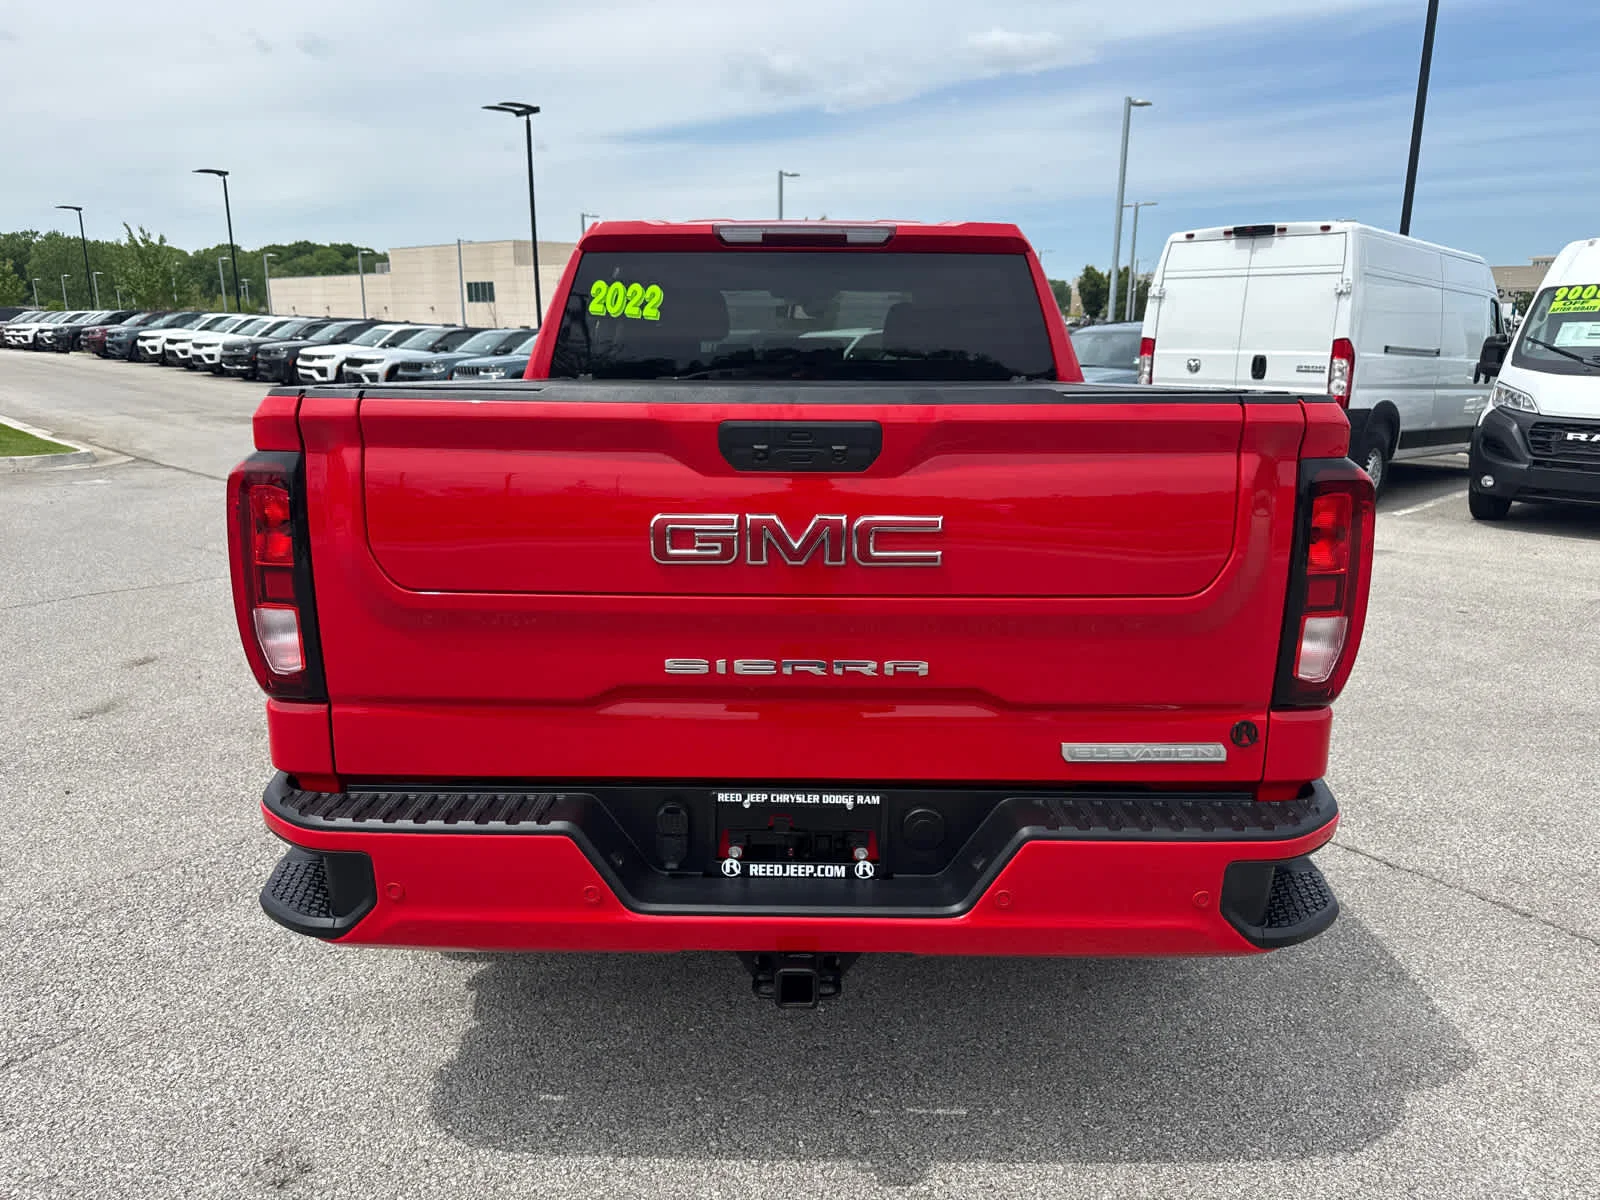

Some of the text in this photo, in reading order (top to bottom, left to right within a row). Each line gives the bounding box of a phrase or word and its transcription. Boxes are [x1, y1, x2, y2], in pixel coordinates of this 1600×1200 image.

[589, 280, 664, 320] 2022
[1554, 285, 1600, 301] 900
[651, 513, 943, 566] GMC
[664, 658, 930, 676] SIERRA
[1073, 746, 1215, 759] ELEVATION
[717, 793, 880, 804] REED JEEP CHRYSLER DODGE RAM
[750, 864, 846, 877] REEDJEEP.COM
